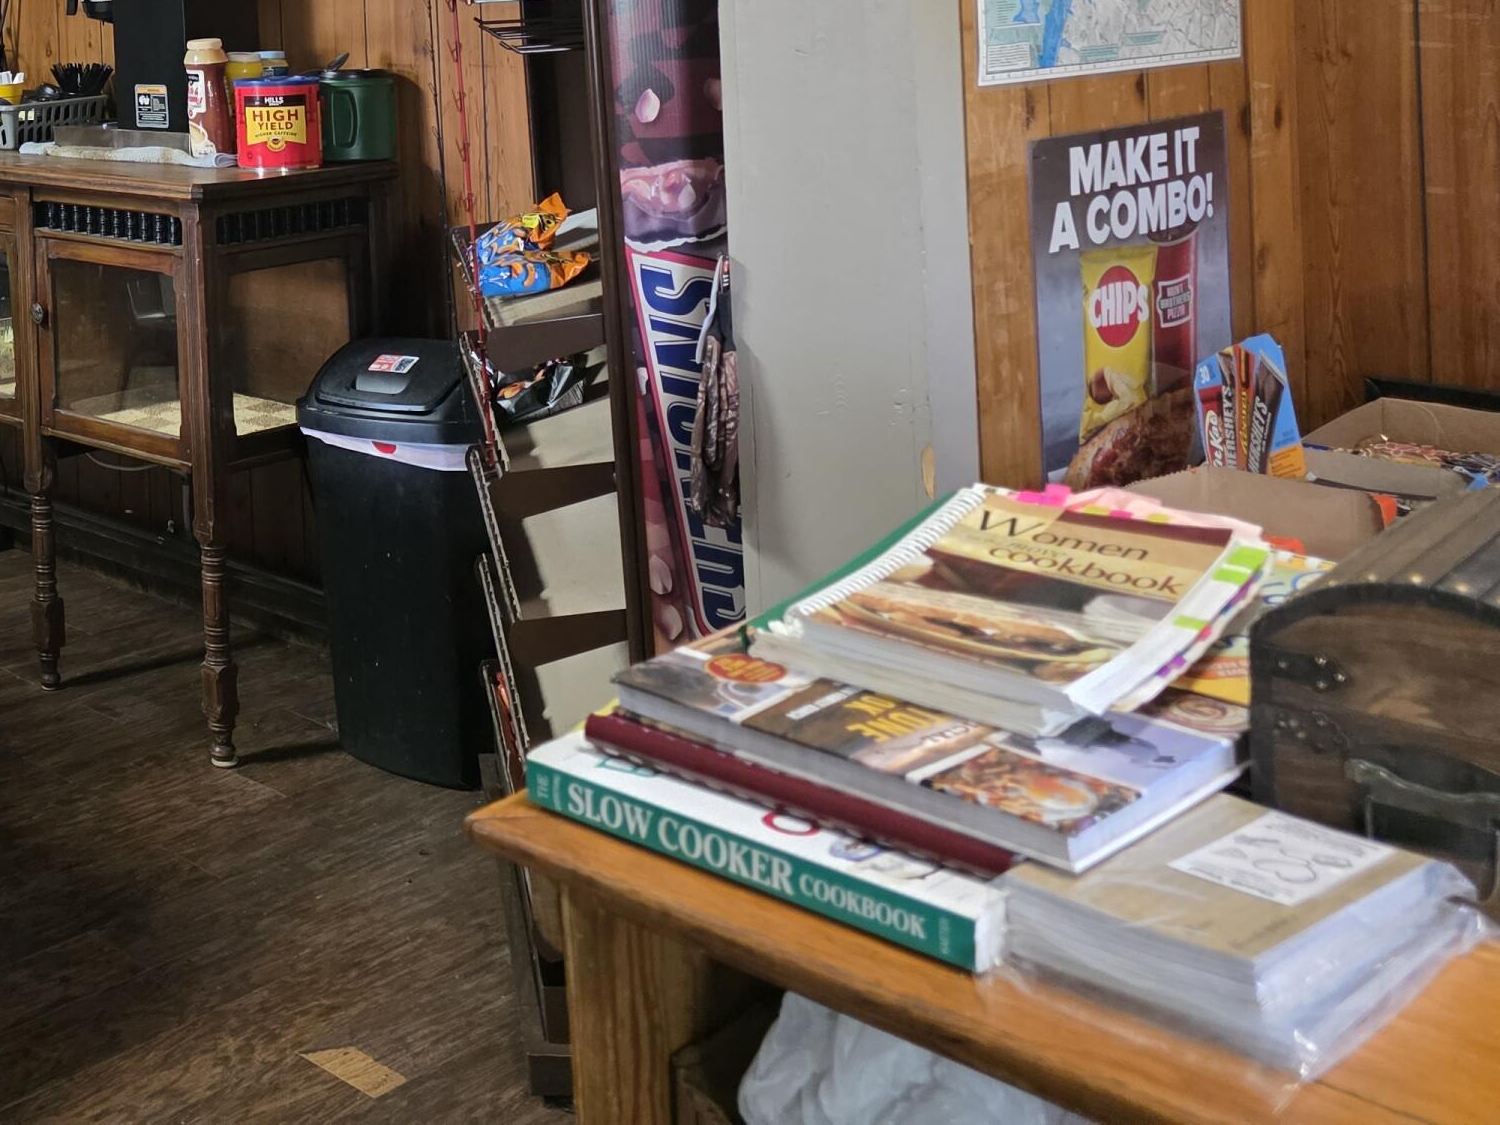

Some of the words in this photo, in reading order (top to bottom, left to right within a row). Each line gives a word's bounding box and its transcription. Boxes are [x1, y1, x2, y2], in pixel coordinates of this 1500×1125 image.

[252, 108, 299, 123] HIGH
[264, 96, 285, 104] HILLS
[258, 122, 293, 131] YIELD
[1069, 132, 1169, 196] MAKE
[1174, 126, 1200, 176] IT
[1049, 201, 1080, 254] A
[1086, 172, 1214, 245] COMBO!
[1089, 280, 1150, 329] CHIPS
[1167, 307, 1186, 321] PIZZA
[640, 263, 748, 633] SNICERS
[979, 509, 1150, 562] Women
[988, 546, 1186, 596] cookbook
[536, 774, 550, 801] THE
[567, 780, 654, 842] SLOW
[656, 815, 796, 897] COOKER
[799, 871, 927, 940] COOKBOOK
